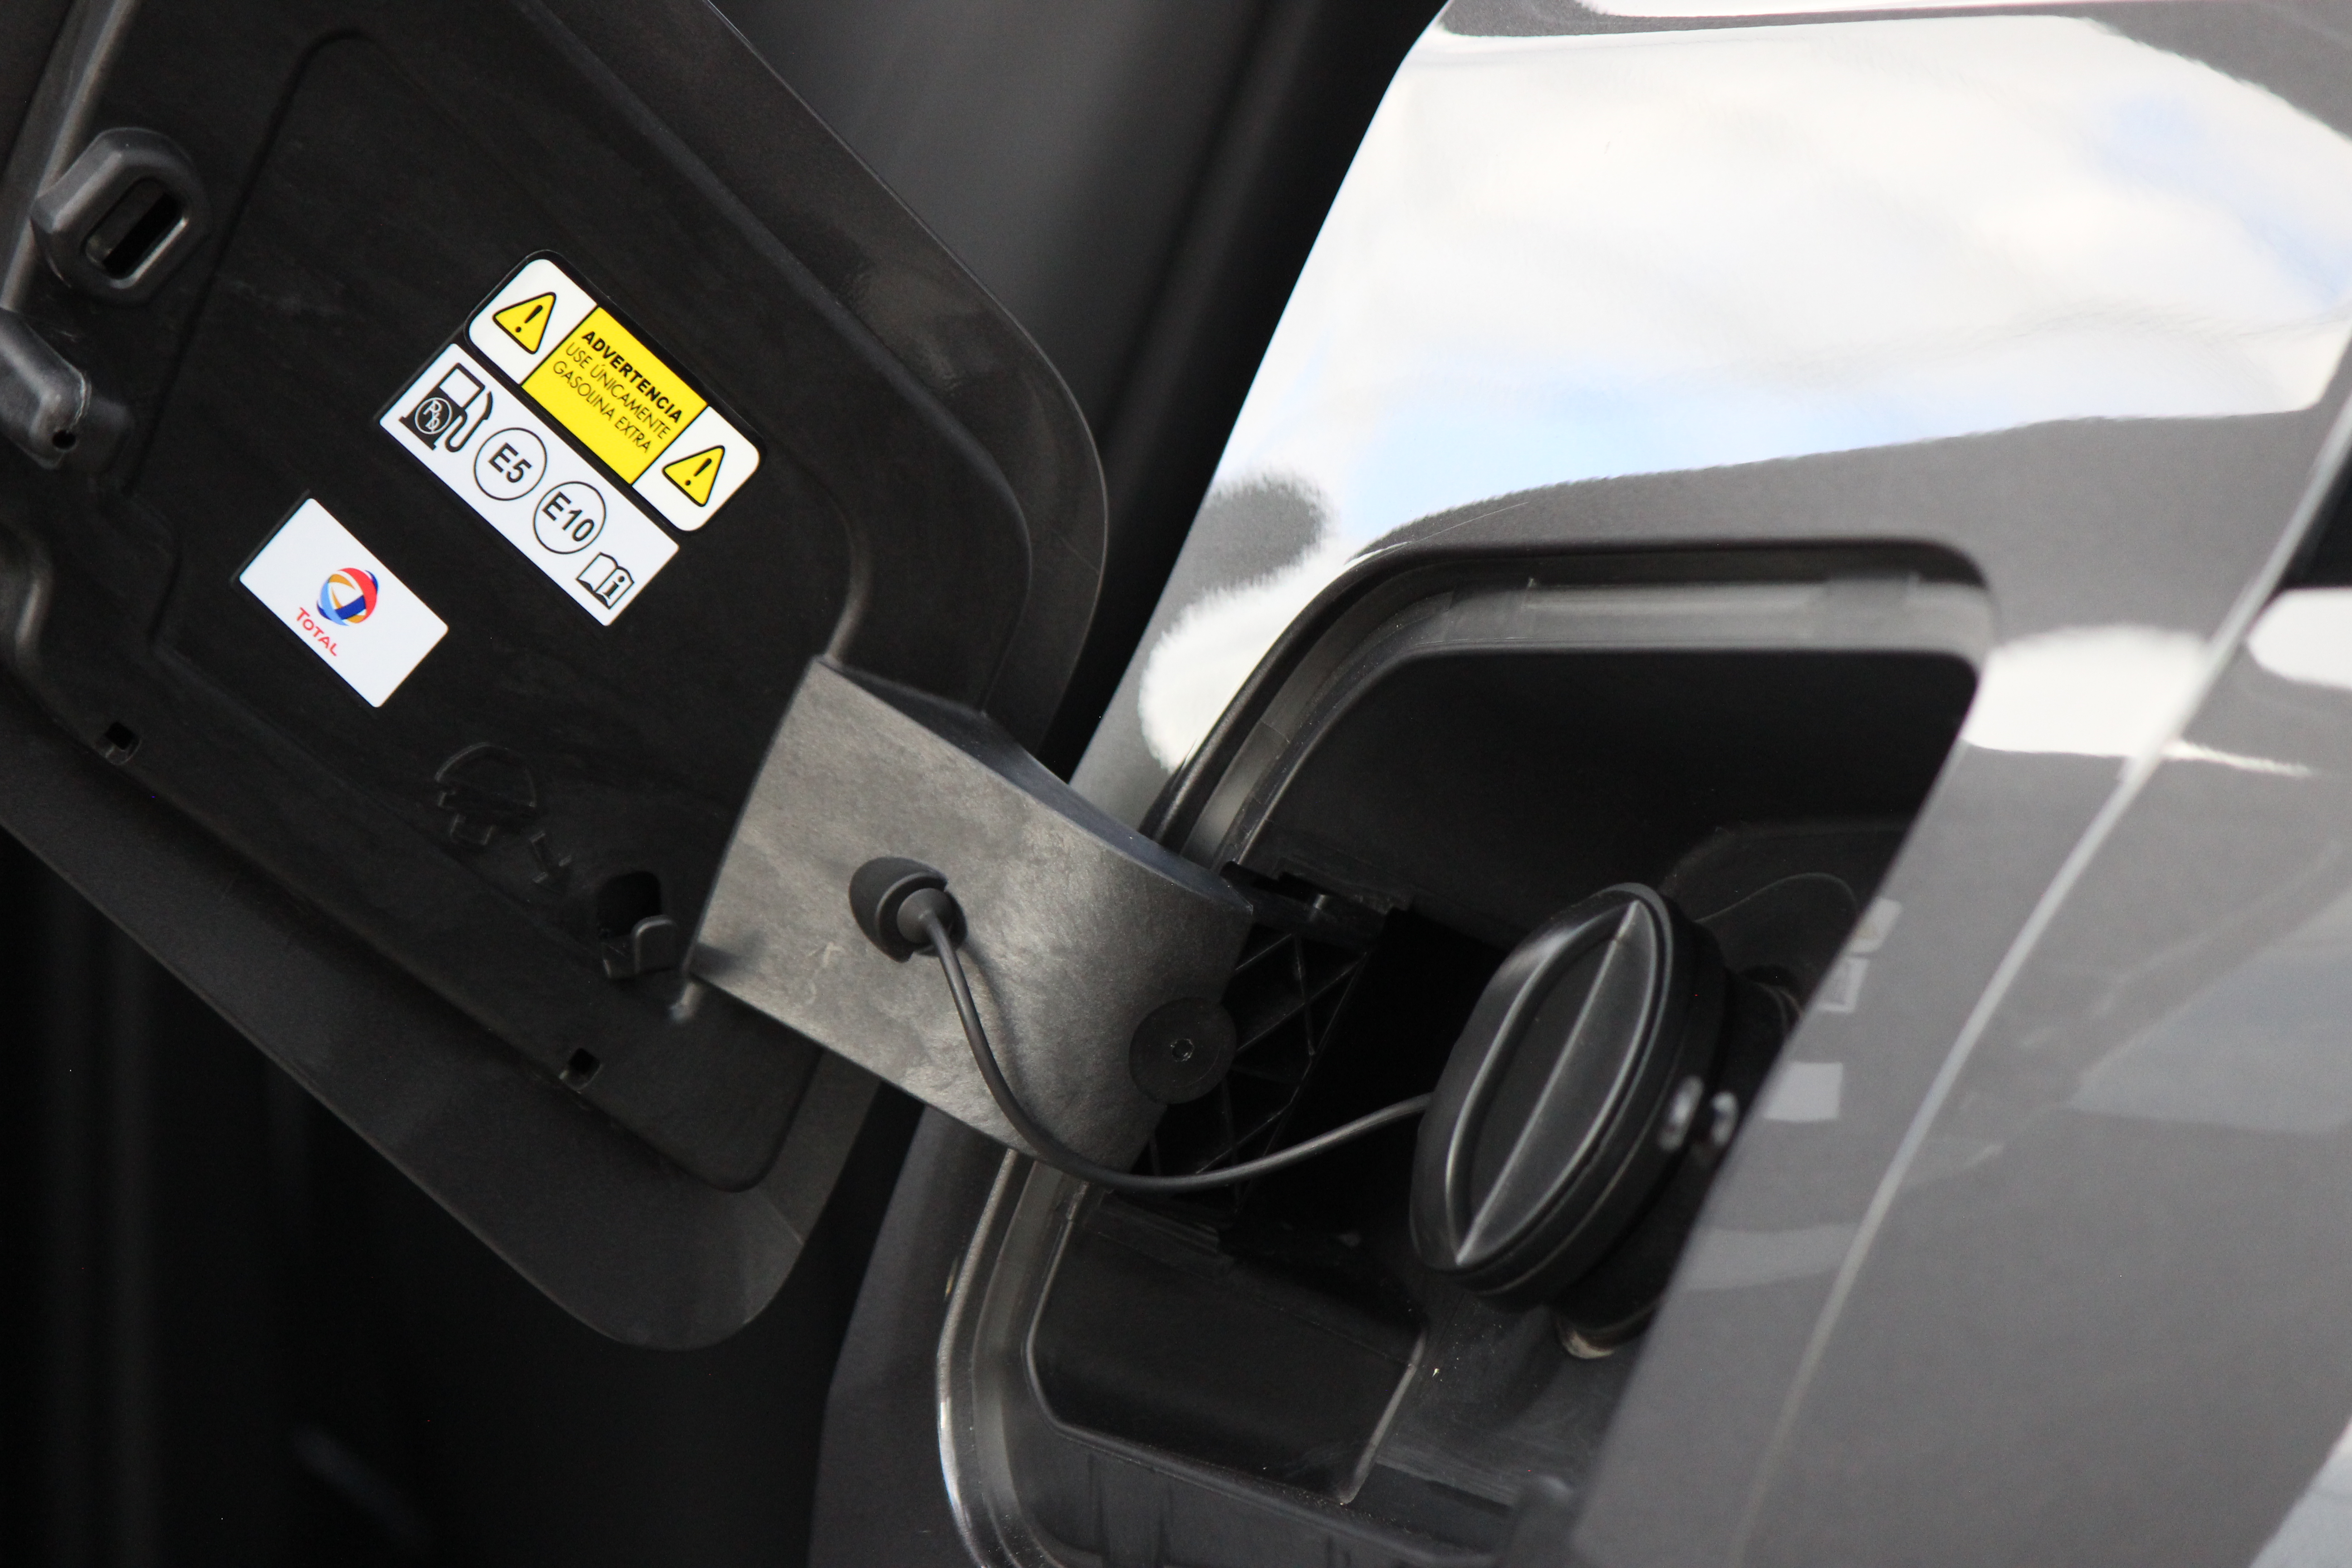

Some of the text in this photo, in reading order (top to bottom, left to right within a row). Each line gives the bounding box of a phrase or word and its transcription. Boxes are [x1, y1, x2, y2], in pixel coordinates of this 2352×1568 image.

[553, 361, 651, 453] GASOLINA EXTRA
[566, 342, 671, 439] USE ÚNICAMENTE
[582, 331, 682, 423] ADVERTENCIA
[488, 442, 594, 542] E5 E10
[296, 607, 338, 657] TOTAL
